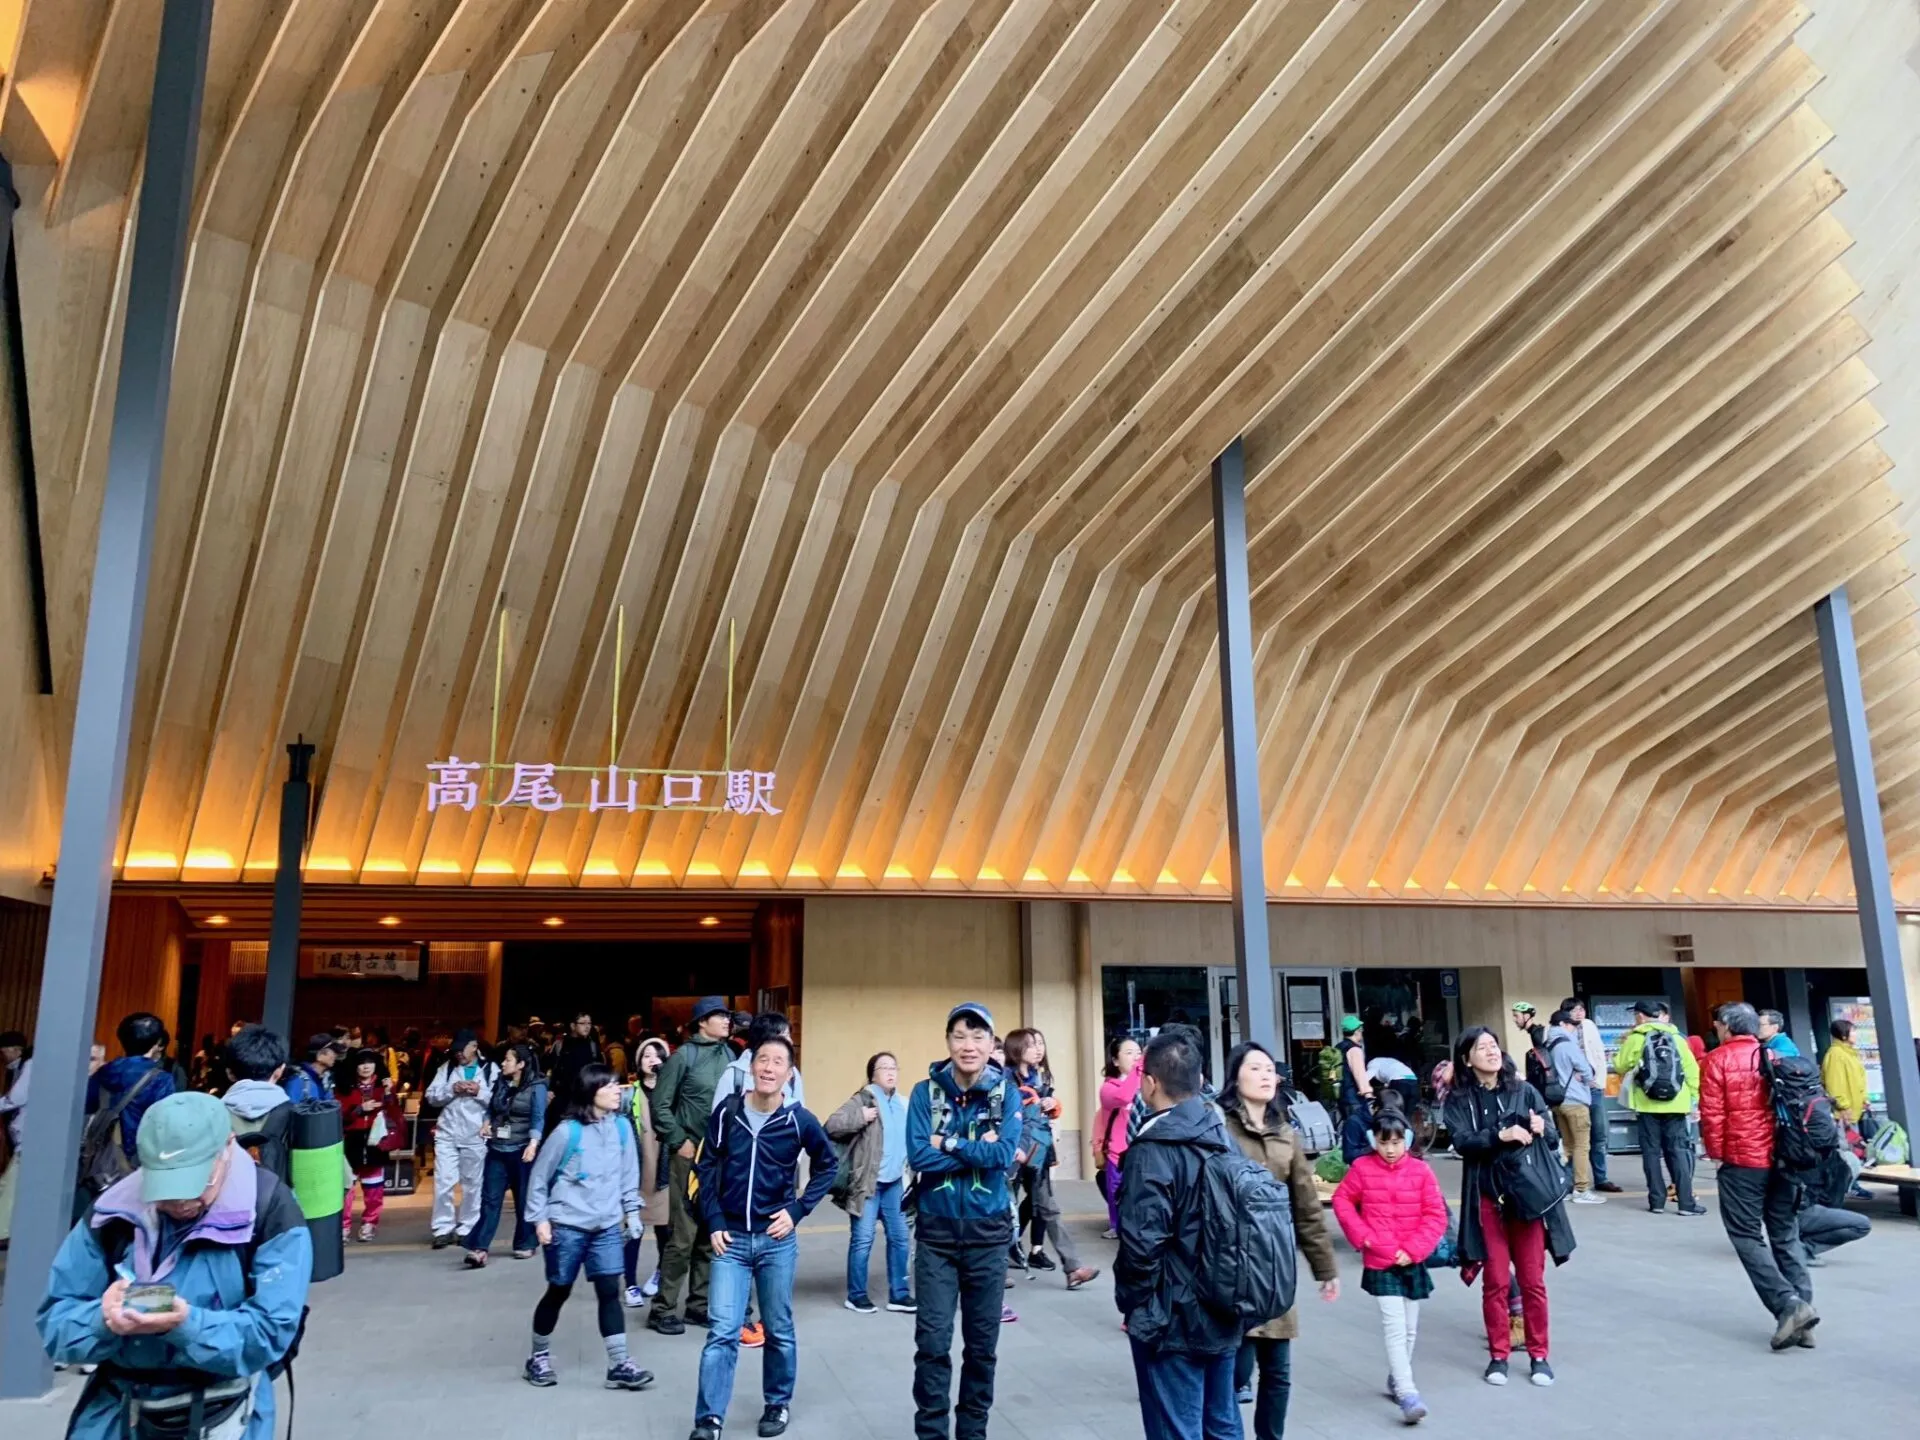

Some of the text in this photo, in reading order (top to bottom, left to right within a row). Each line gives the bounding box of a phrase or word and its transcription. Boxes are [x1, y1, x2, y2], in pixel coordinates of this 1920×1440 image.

[426, 756, 782, 816] 高尾山口駅
